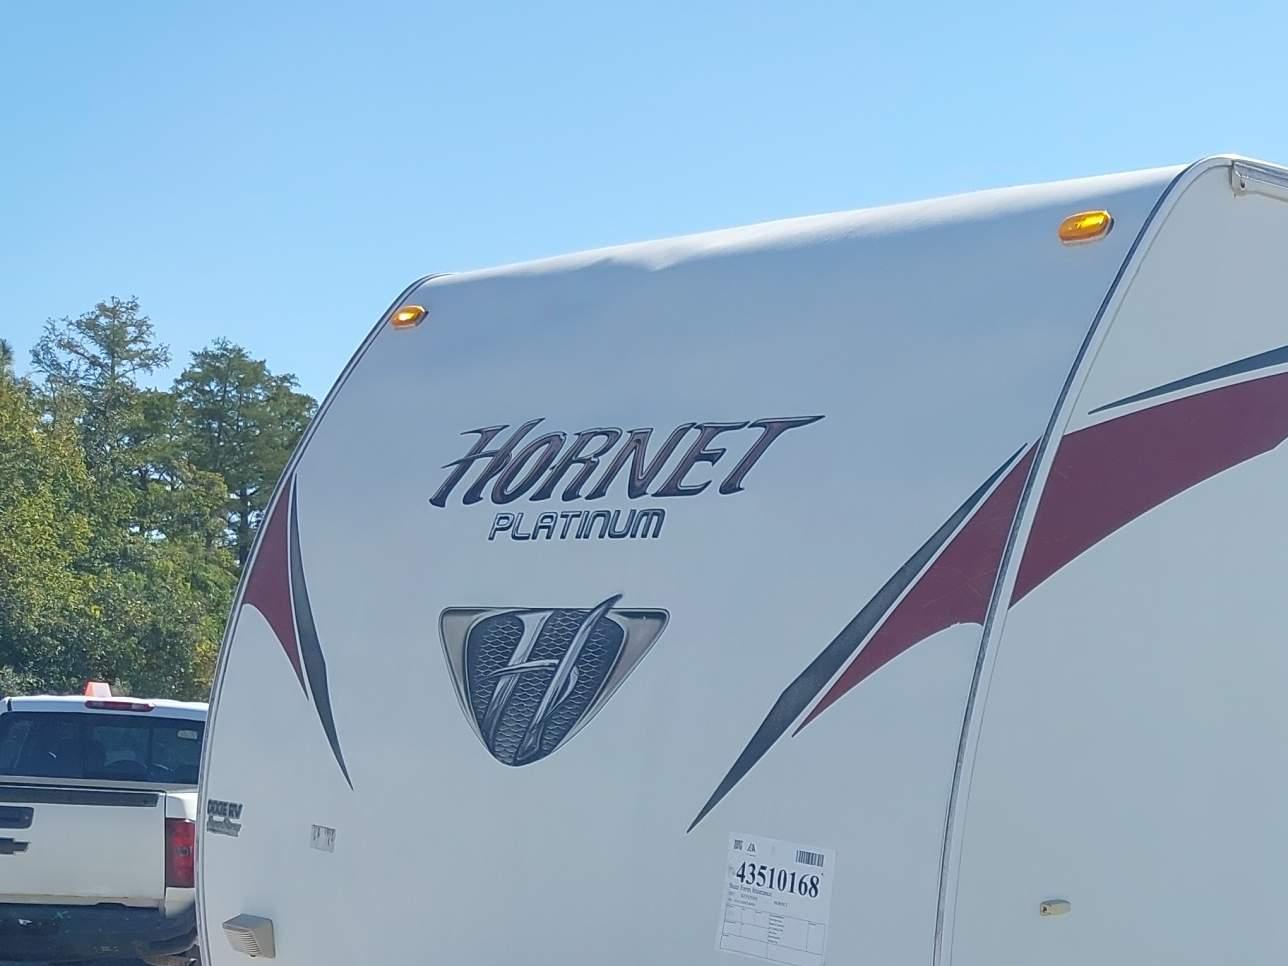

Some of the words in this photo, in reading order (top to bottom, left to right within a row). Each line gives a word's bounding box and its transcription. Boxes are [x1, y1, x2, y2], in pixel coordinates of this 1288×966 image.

[429, 416, 825, 507] HORNET
[488, 508, 666, 540] PLATINUM
[736, 861, 820, 898] 43510168
